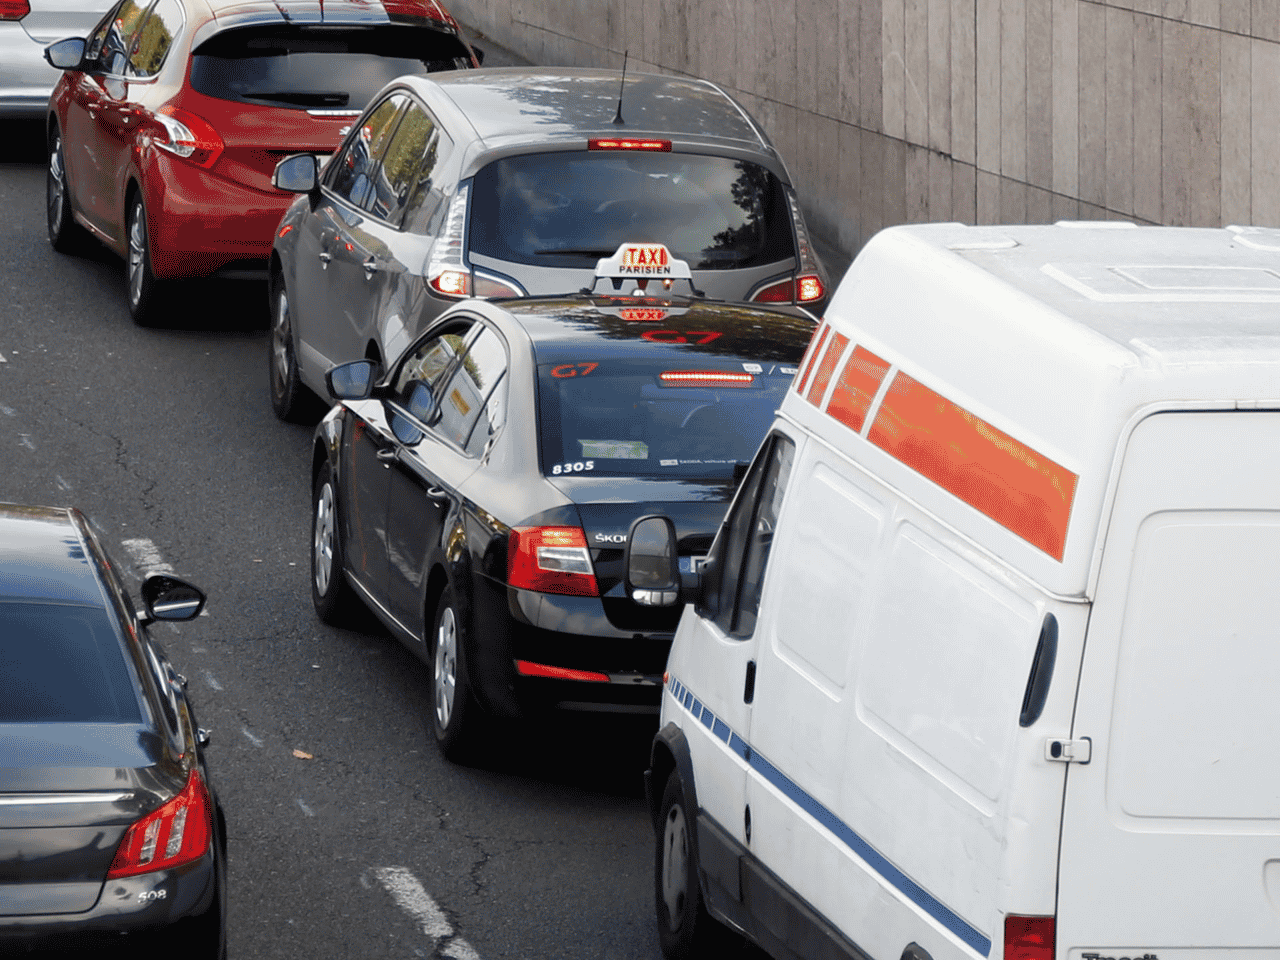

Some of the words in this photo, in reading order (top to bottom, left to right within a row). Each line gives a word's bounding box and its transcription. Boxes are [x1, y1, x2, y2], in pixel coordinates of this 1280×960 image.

[628, 248, 665, 265] TAXI
[619, 266, 671, 274] PARISIEN
[641, 329, 723, 344] G7
[551, 362, 599, 378] G7
[552, 460, 595, 475] 8305
[137, 889, 167, 905] 508
